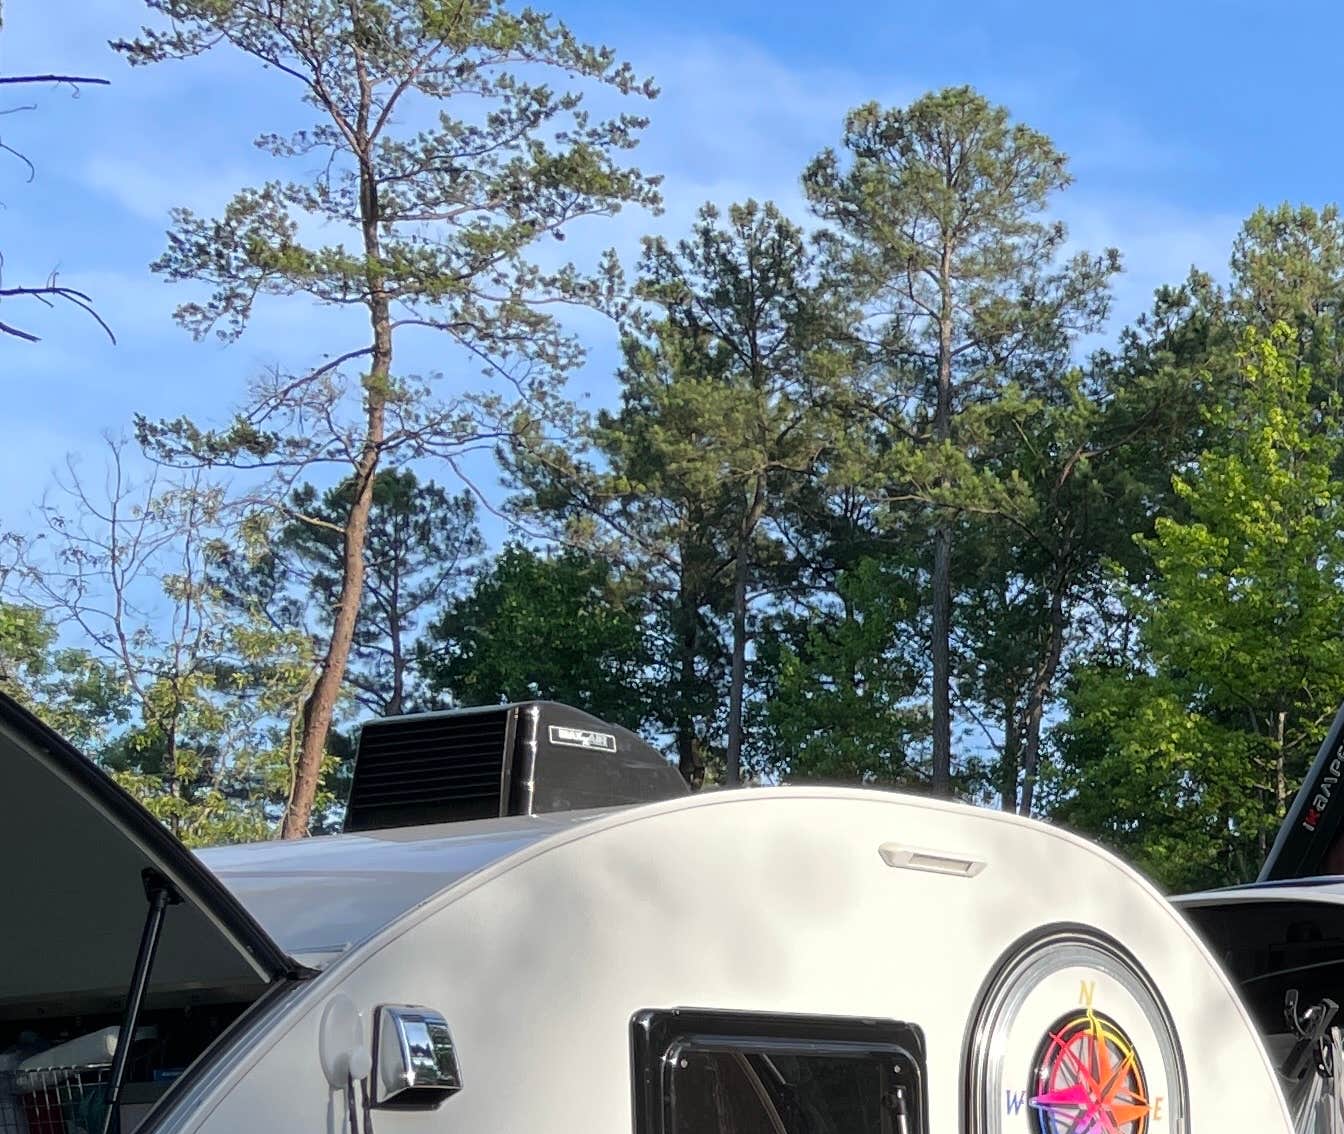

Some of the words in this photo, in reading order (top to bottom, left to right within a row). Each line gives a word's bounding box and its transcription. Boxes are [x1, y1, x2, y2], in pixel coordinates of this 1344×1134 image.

[1078, 979, 1096, 1006] N
[1005, 1089, 1027, 1116] W
[1152, 1096, 1164, 1121] E
